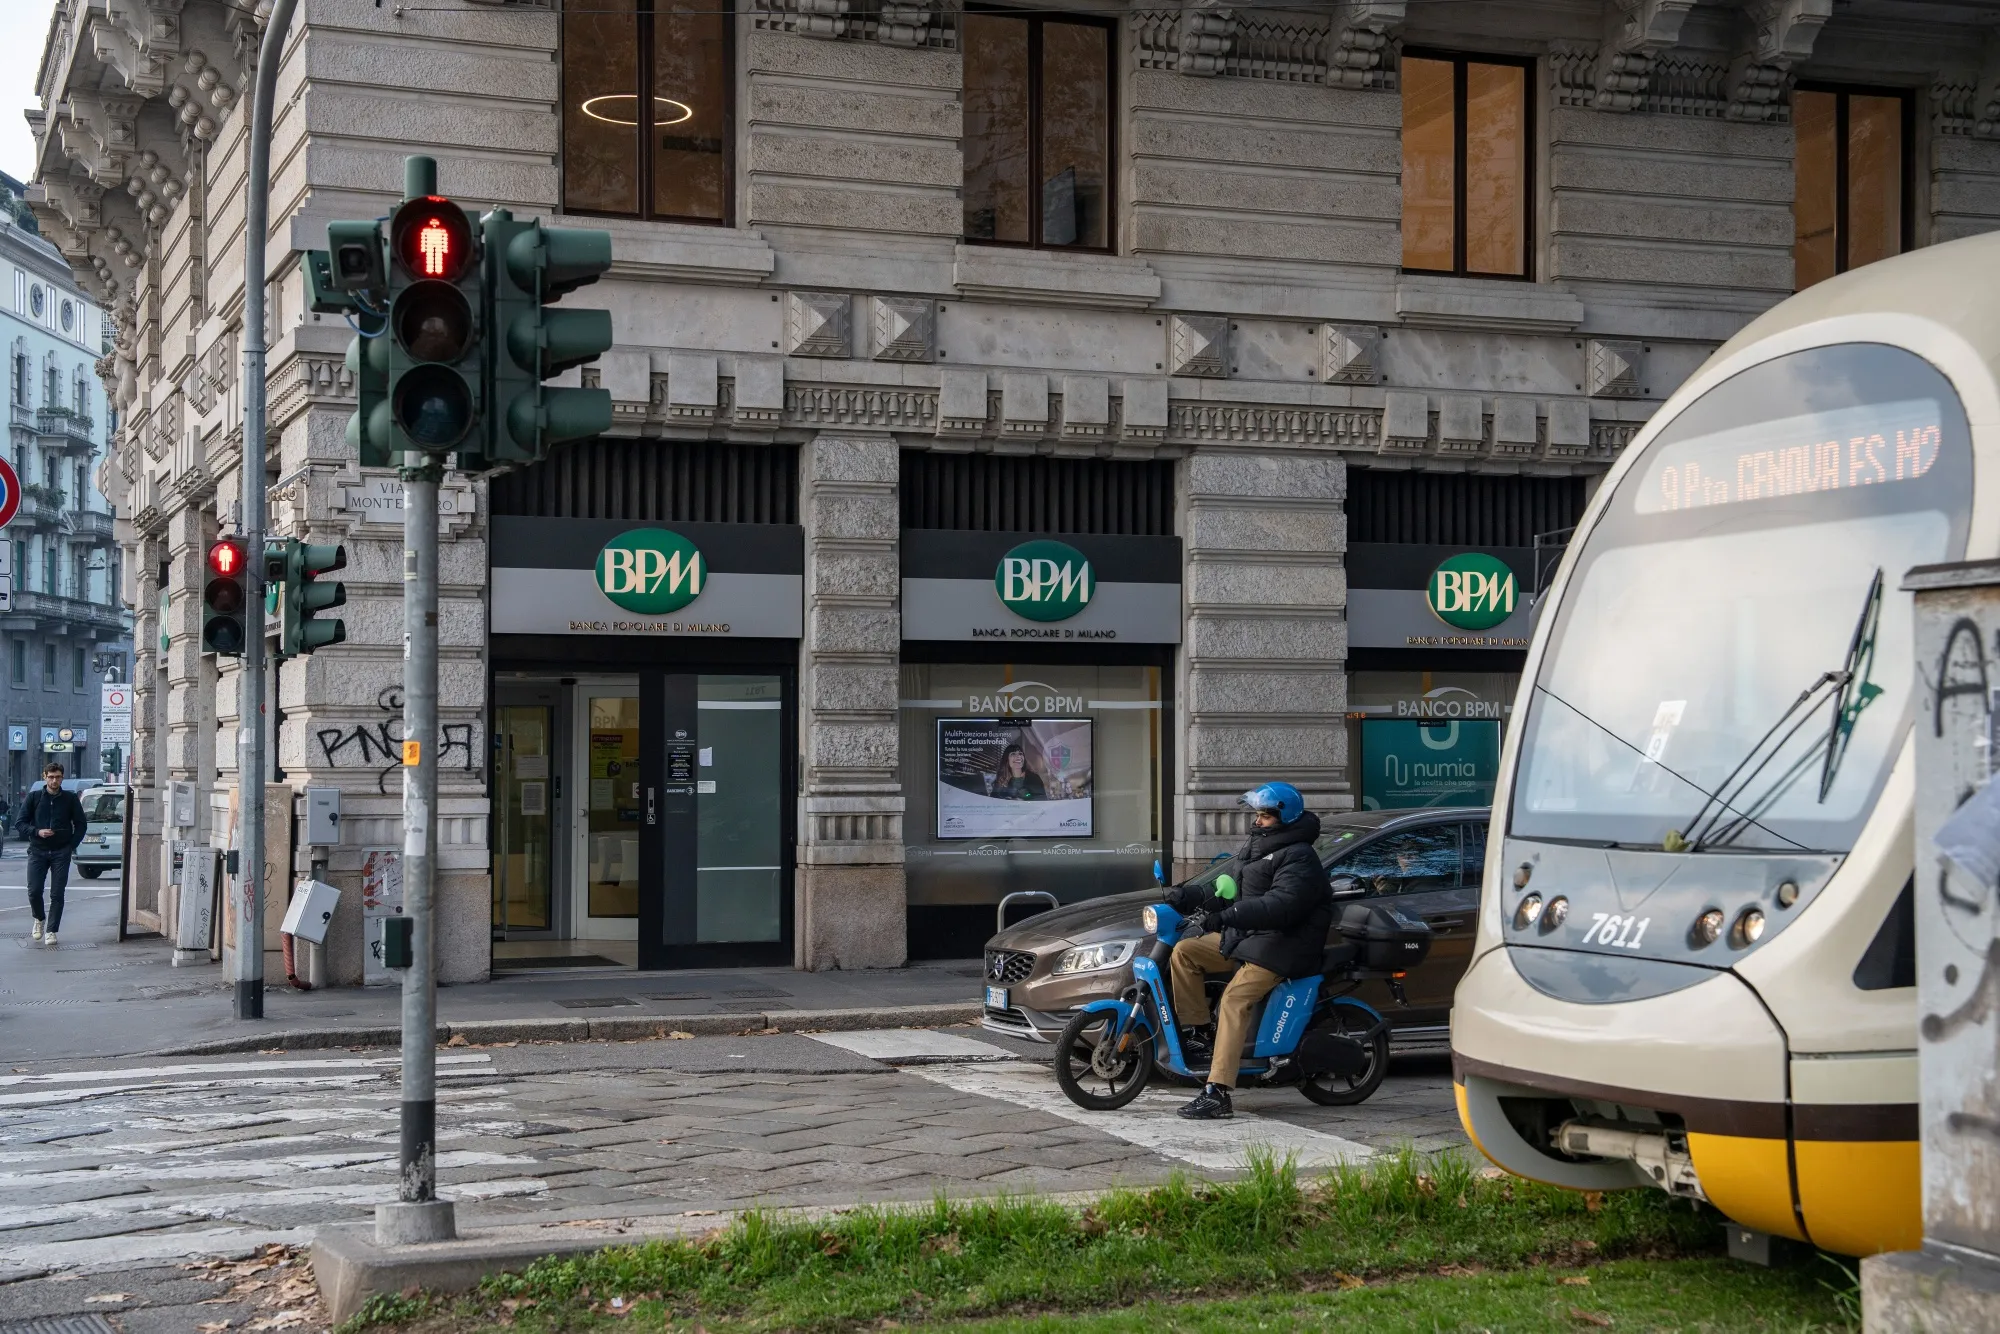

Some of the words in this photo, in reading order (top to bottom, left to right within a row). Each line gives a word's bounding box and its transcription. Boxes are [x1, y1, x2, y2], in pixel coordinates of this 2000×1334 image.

[1662, 466, 1678, 511] 9
[1737, 441, 1839, 502] GENOVA
[604, 548, 700, 595] BPM
[1003, 558, 1089, 603] BPM
[1436, 570, 1514, 613] BPM
[568, 620, 609, 632] BANCA
[612, 621, 669, 633] POPOLARE
[673, 622, 684, 633] DI
[687, 623, 731, 634] MILANO
[972, 628, 1006, 638] BANCA
[1011, 628, 1060, 639] POPOLARE
[1065, 629, 1074, 639] DI
[1078, 630, 1116, 639] MILANO
[1406, 636, 1439, 645] BANCA
[1441, 636, 1487, 646] POPOLARE
[1489, 637, 1499, 646] DI
[1502, 637, 1529, 647] MILAN
[969, 695, 1040, 713] BANCO
[1044, 696, 1083, 713] BPM
[1398, 701, 1461, 717] BANCO
[1465, 701, 1499, 717] BPM
[1414, 758, 1475, 777] numia
[1582, 913, 1651, 949] 7611
[1272, 1010, 1289, 1044] cooltra
